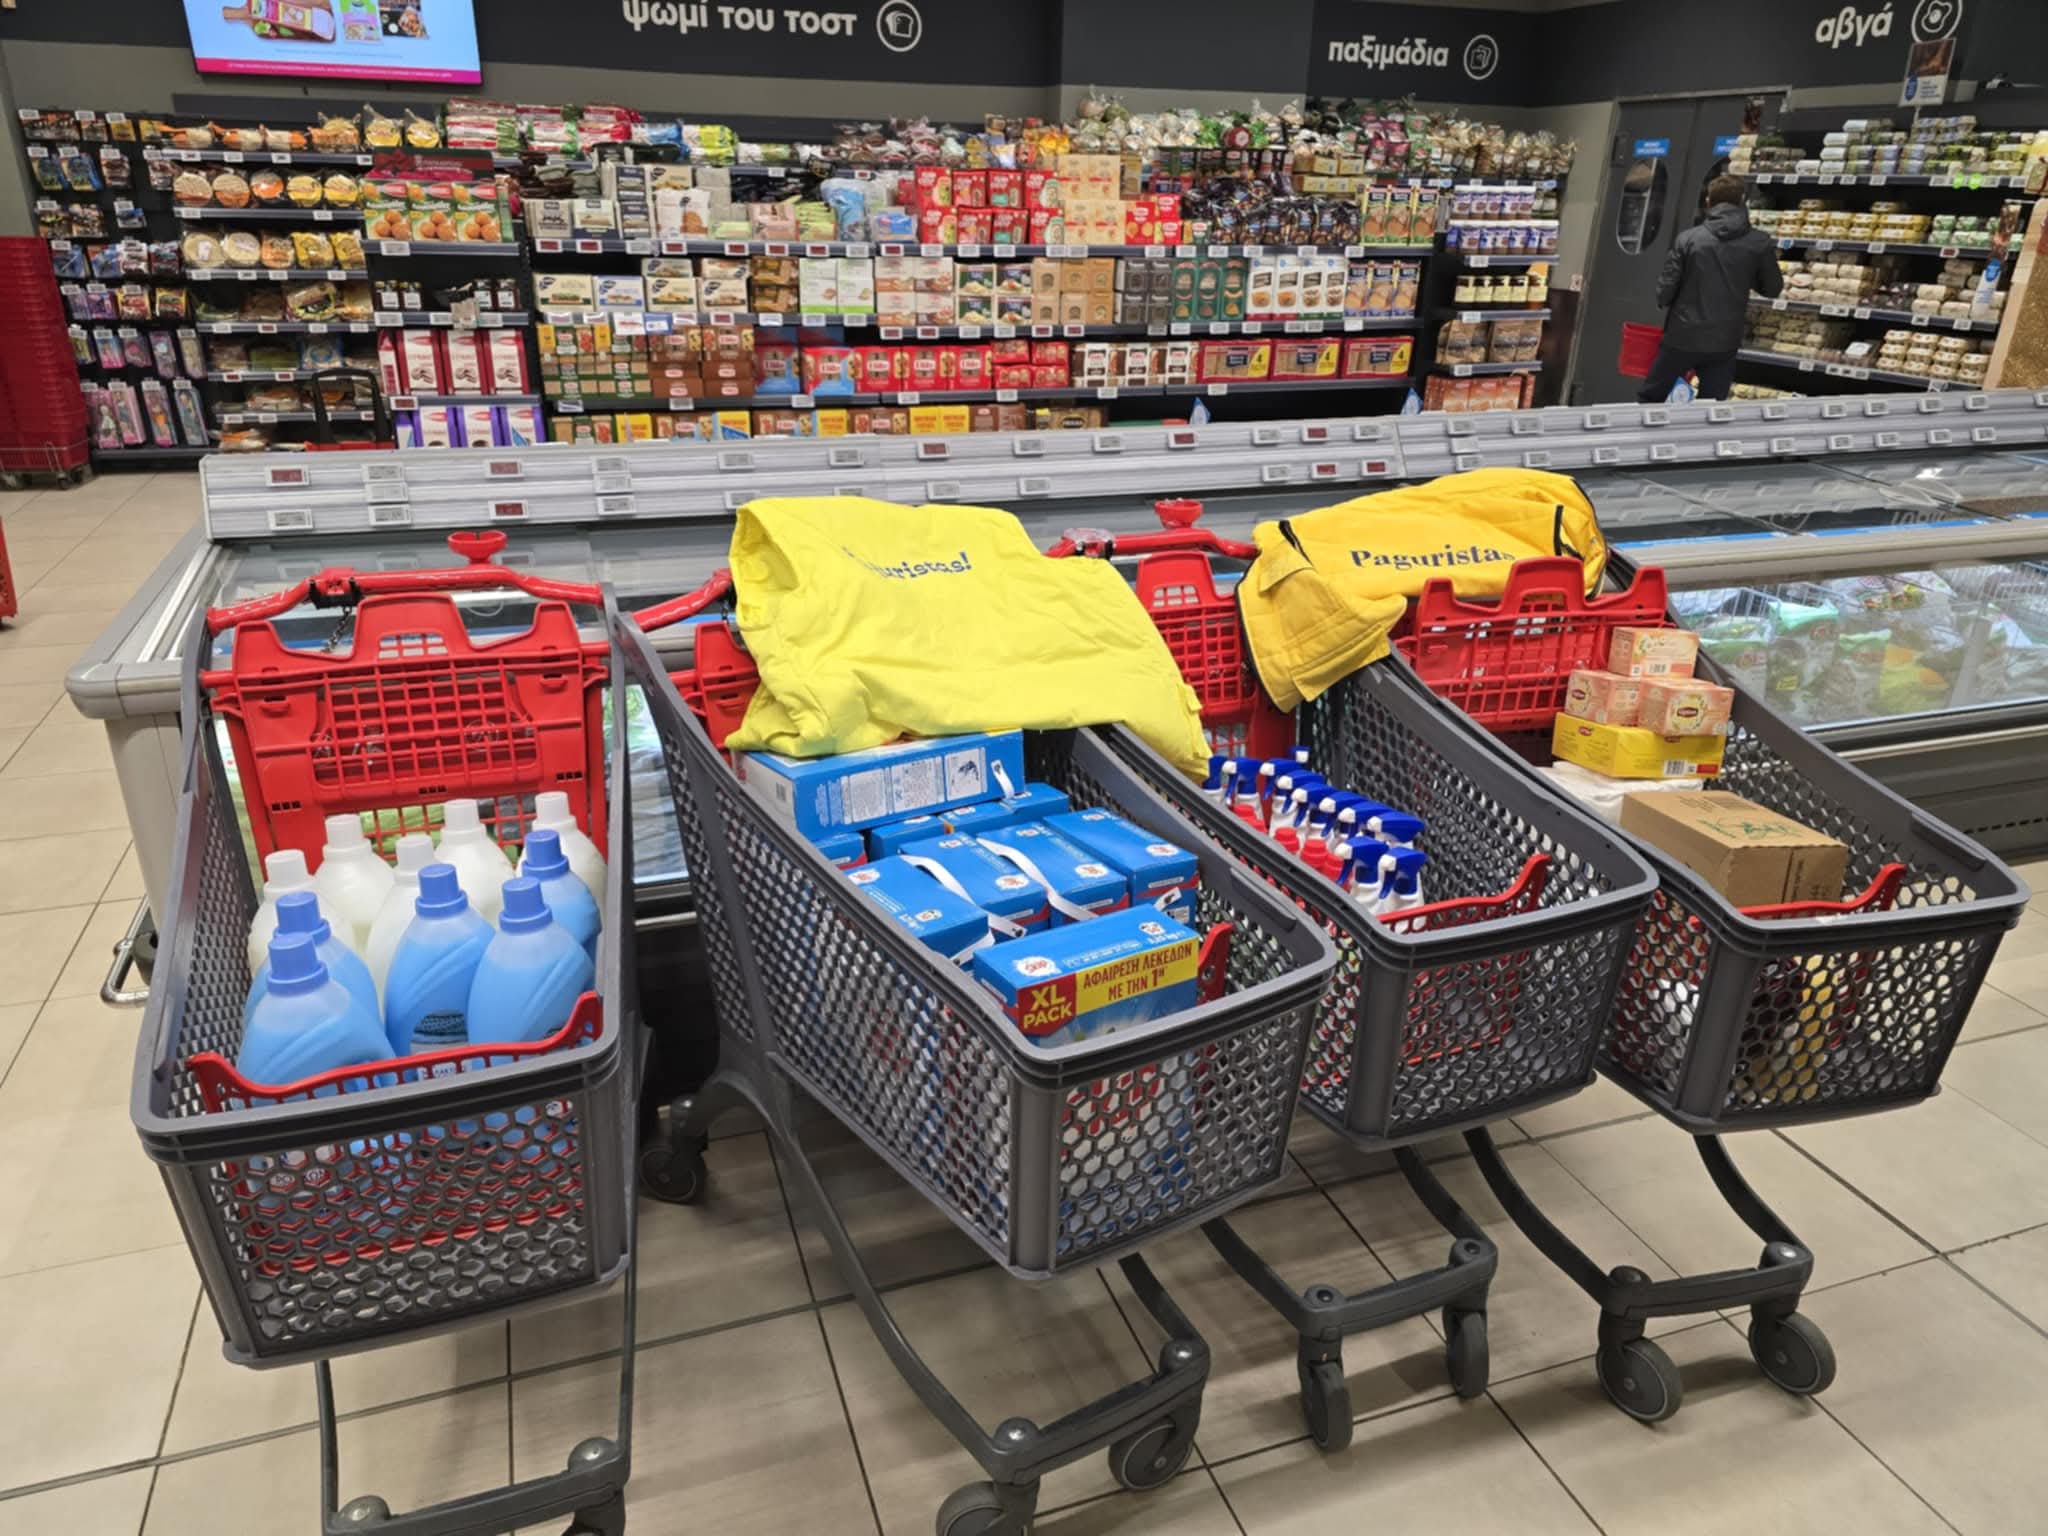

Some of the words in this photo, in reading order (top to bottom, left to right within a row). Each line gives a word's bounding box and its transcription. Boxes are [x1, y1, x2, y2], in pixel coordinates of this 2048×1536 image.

[622, 0, 708, 34] ψωμί
[717, 6, 775, 32] του
[784, 10, 858, 36] τοστ
[1815, 2, 1894, 49] αβγά
[1328, 35, 1449, 71] παξιμάδια
[1083, 957, 1140, 990] ΑΦΑΙΡΕΣΗ
[1142, 942, 1193, 969] ΛΕΚΕΔΩΝ
[1031, 983, 1066, 1012] XL
[1108, 983, 1123, 1001] ΜΕ
[1126, 975, 1148, 996] ΤΗΝ
[1023, 1002, 1073, 1029] PACK
